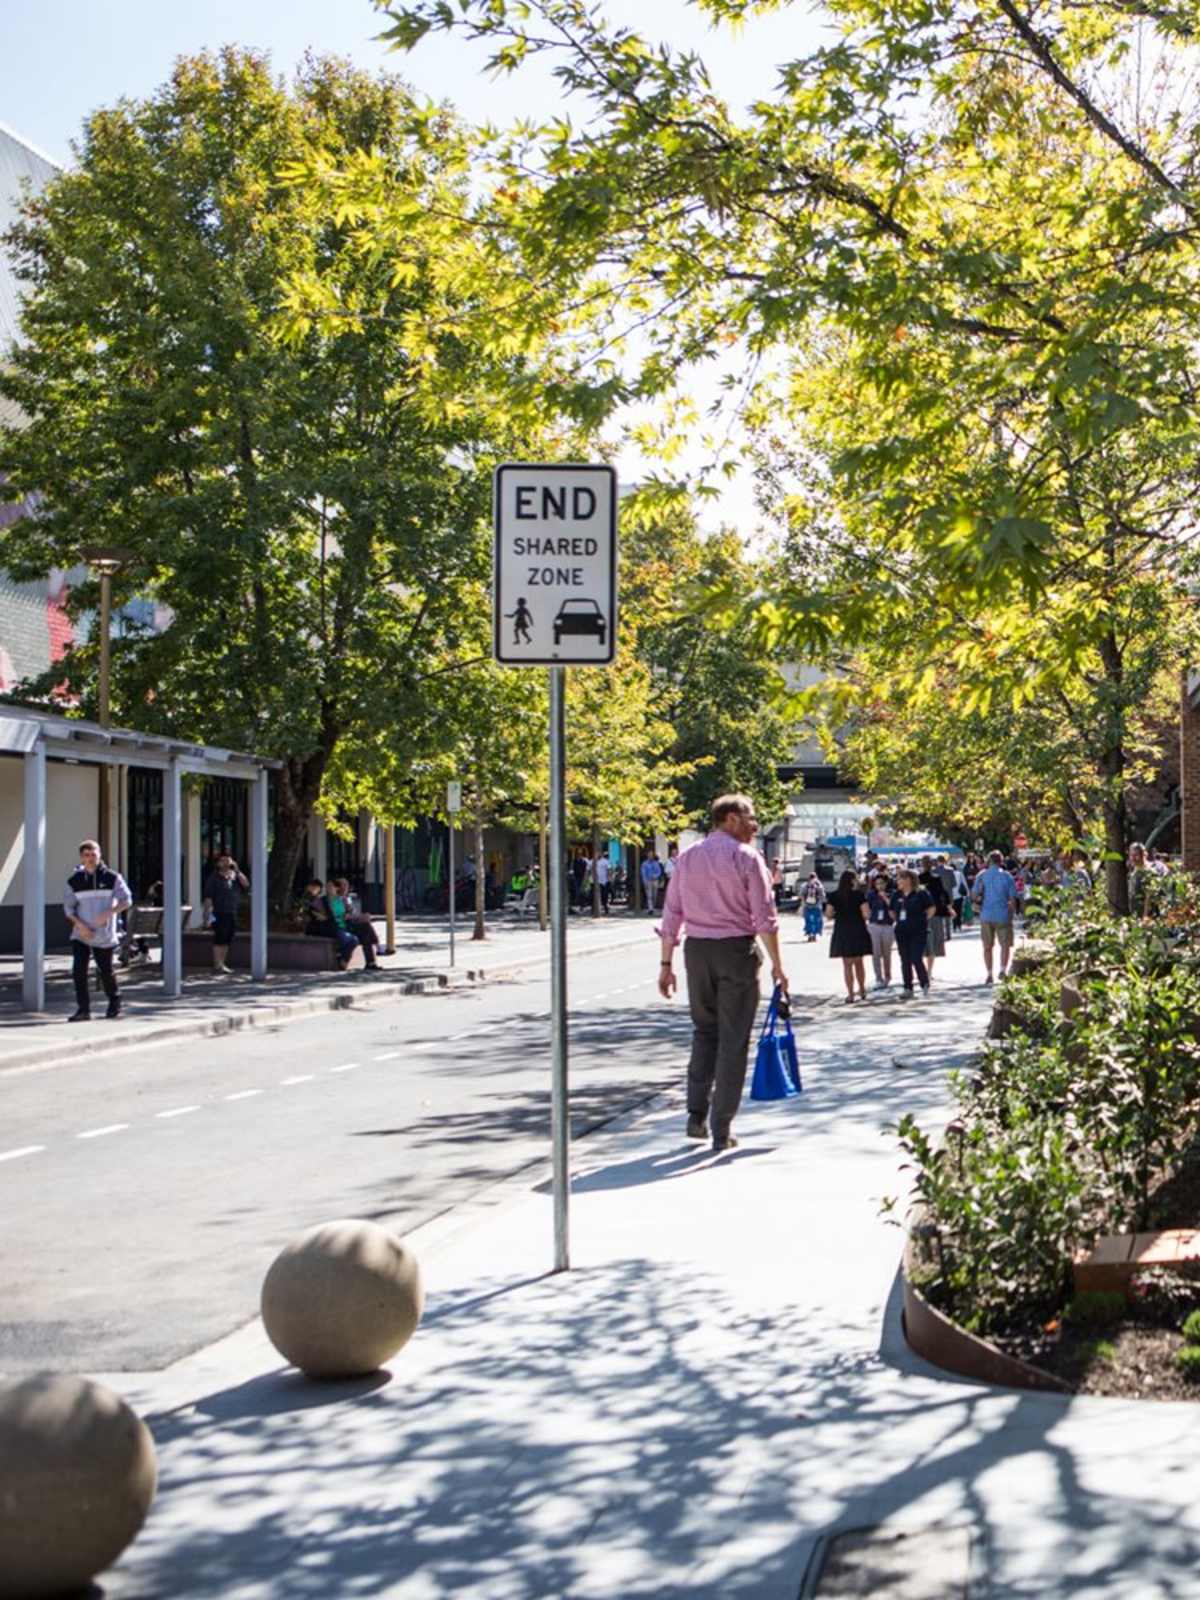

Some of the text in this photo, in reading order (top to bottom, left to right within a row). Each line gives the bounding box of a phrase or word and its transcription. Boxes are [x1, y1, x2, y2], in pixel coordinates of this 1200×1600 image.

[515, 486, 597, 521] END
[513, 537, 598, 556] SHARED
[527, 567, 584, 586] ZONE
